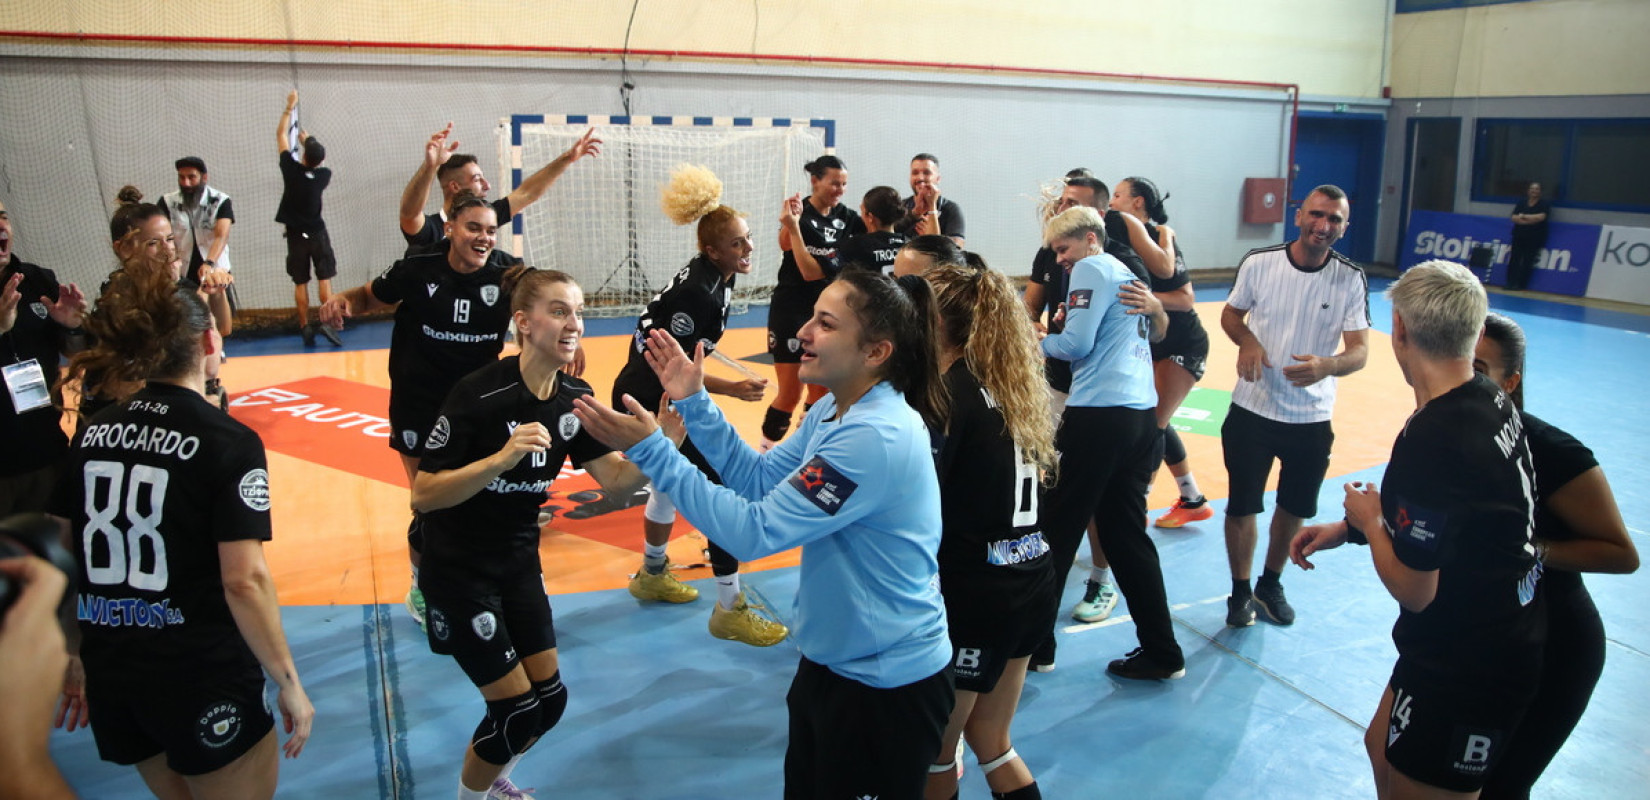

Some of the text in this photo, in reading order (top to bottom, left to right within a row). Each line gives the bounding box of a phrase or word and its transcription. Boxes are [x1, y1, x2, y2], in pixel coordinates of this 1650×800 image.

[1602, 231, 1650, 267] ko
[453, 298, 471, 323] 19
[81, 422, 200, 460] BROCARDO
[84, 460, 169, 592] 88
[956, 647, 981, 669] B
[1391, 688, 1412, 730] 14
[1463, 734, 1491, 763] B
